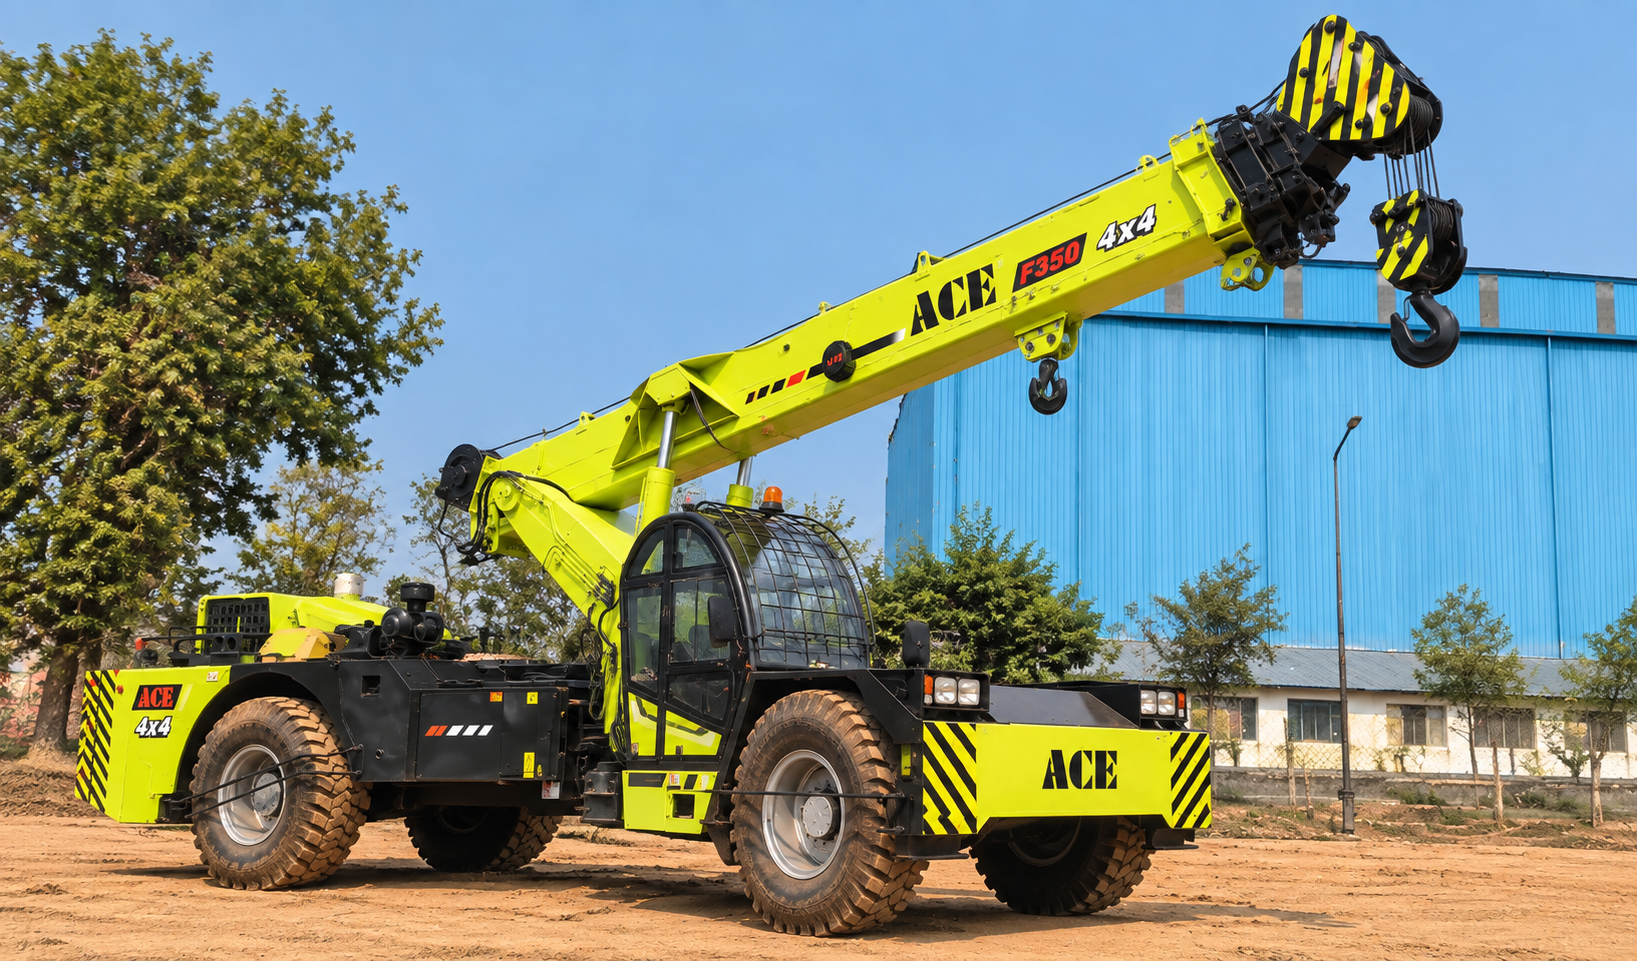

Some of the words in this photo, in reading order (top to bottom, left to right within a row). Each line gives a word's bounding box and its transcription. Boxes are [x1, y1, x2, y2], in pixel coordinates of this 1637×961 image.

[911, 263, 997, 336] ACE
[1019, 240, 1080, 285] F350
[1096, 203, 1157, 252] 4x4
[138, 687, 174, 708] ACE
[135, 715, 172, 738] 4x4
[1042, 749, 1117, 789] ACE
